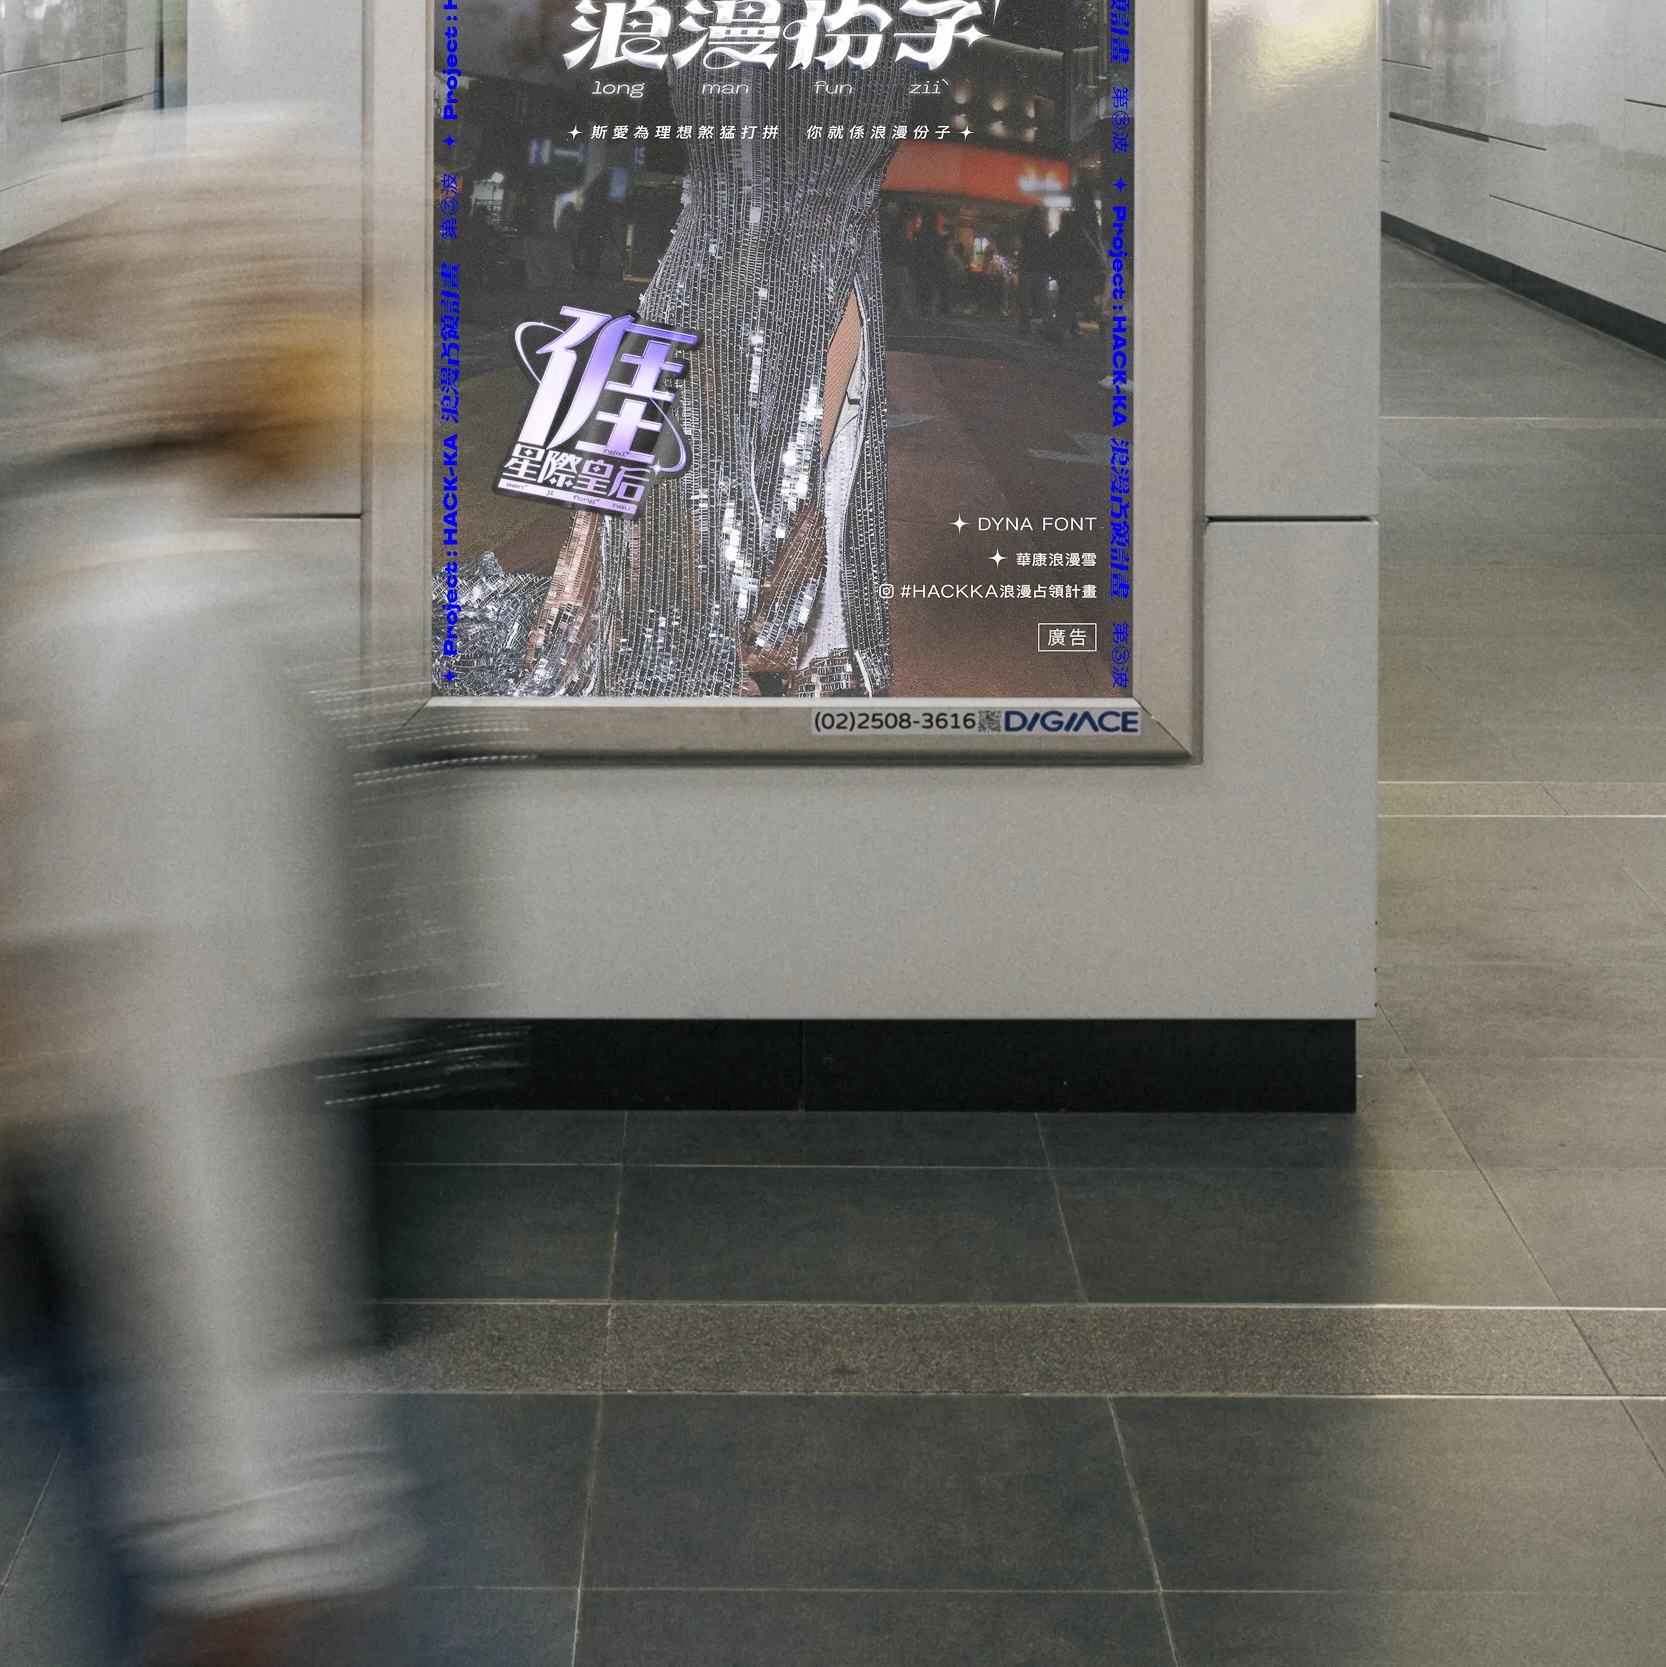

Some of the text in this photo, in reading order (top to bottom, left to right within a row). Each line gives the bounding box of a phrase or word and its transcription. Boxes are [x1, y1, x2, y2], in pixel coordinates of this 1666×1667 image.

[591, 80, 645, 99] long
[701, 82, 750, 95] man
[813, 80, 854, 95] fun
[590, 124, 952, 141] 斯愛為理想煞猛打拼 你就係浪漫份子
[502, 443, 651, 502] 星際皇后
[977, 516, 1098, 532] DYNA FONT
[1015, 552, 1098, 568] 華康浪漫雪
[900, 583, 1098, 600] #HACKKA浪漫占領計畫
[1047, 628, 1088, 647] 廣告
[813, 711, 976, 732] (02)2508-3616
